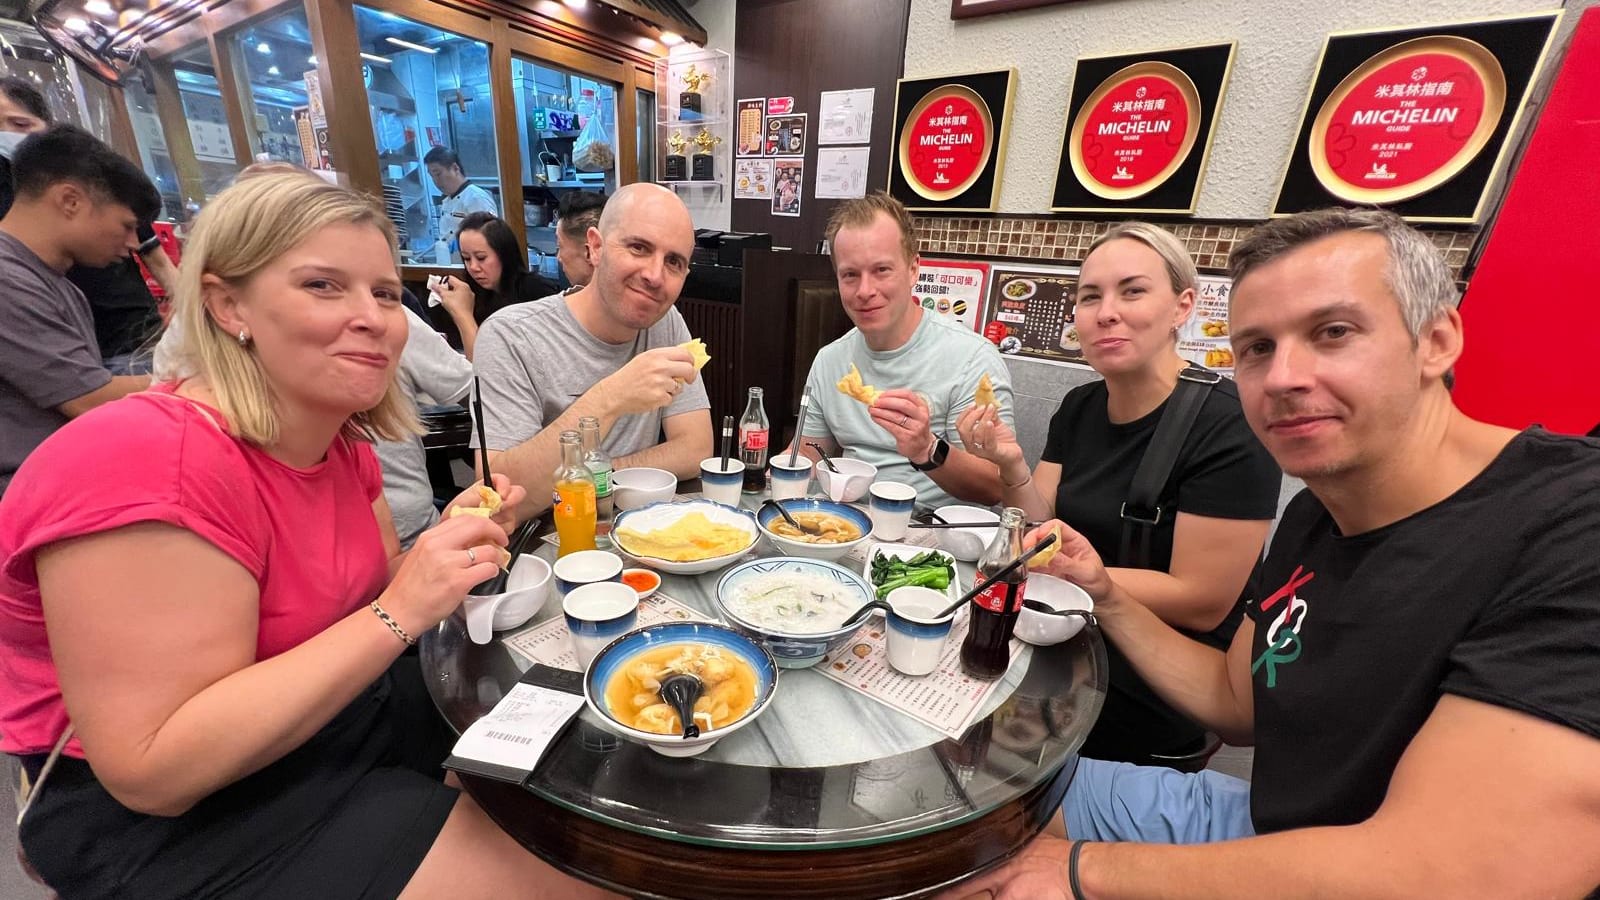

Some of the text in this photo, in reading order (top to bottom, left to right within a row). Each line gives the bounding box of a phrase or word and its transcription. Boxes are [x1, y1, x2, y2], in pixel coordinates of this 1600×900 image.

[1374, 81, 1455, 98] 米其林指南
[1112, 98, 1166, 113] 米其林指南
[1400, 100, 1417, 108] THE
[929, 115, 968, 127] 米其林指南
[1351, 107, 1459, 125] MICHELIN
[1098, 120, 1171, 135] MICHELIN
[1386, 125, 1412, 133] GUIDE
[920, 133, 973, 146] MICHELIN
[1202, 283, 1229, 297] 小食
